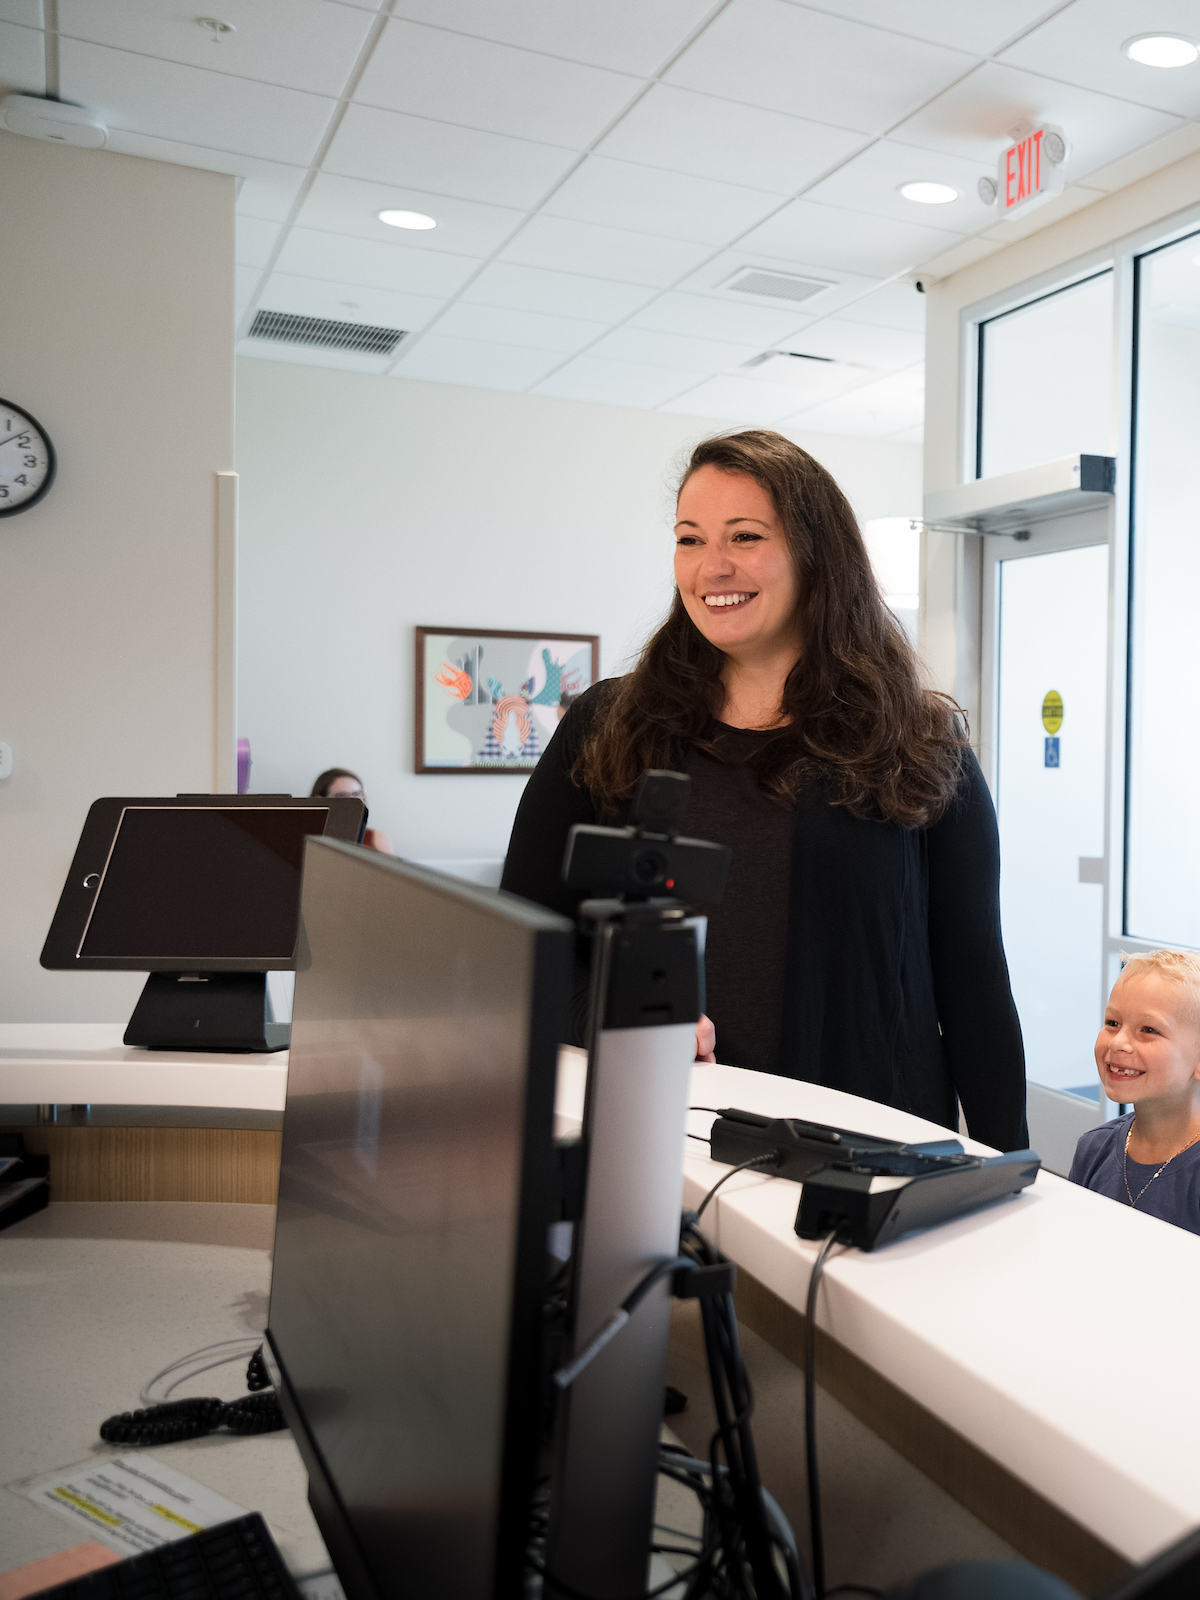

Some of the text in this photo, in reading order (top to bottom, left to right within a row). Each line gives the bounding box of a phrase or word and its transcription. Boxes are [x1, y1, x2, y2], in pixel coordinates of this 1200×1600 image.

[1006, 130, 1043, 208] EXIT
[18, 436, 31, 449] 2
[23, 455, 37, 468] 3
[14, 474, 28, 486] 4
